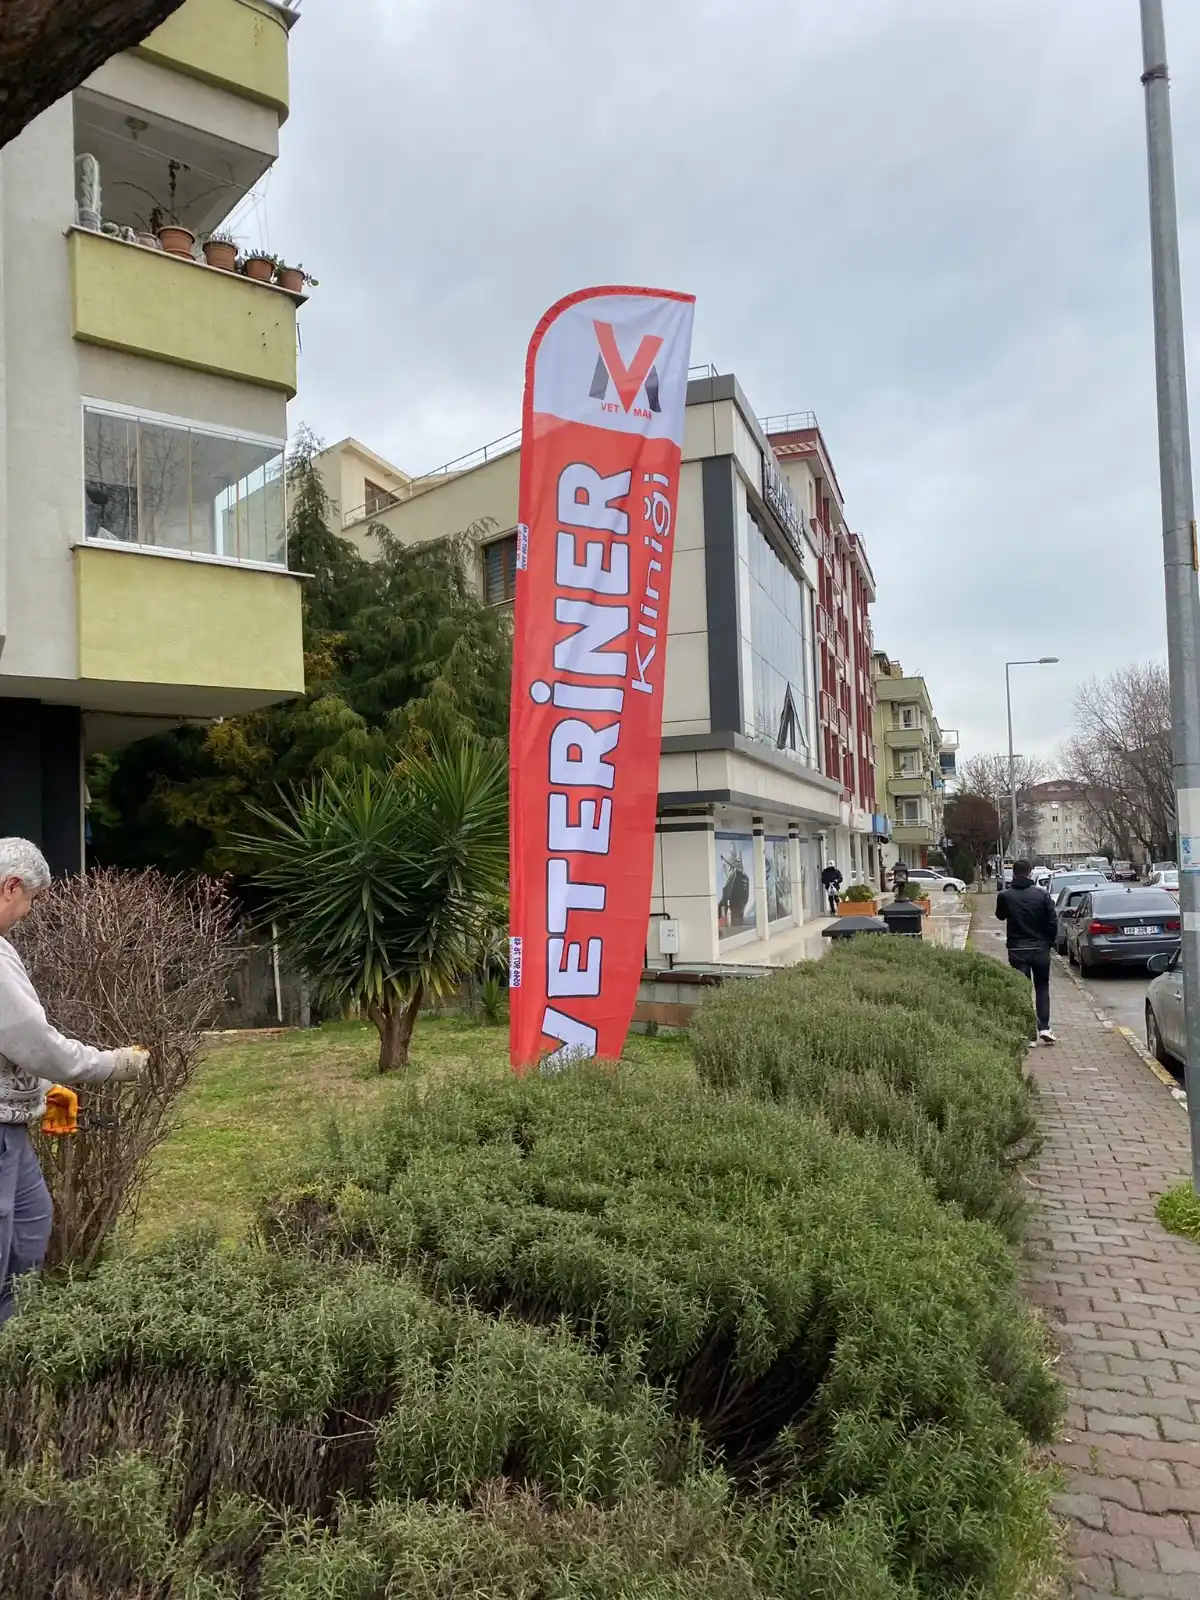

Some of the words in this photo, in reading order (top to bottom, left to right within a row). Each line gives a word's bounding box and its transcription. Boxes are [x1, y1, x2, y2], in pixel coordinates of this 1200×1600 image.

[600, 401, 620, 414] VET
[631, 472, 671, 695] Kliniği
[530, 462, 632, 1074] VETERİNER
